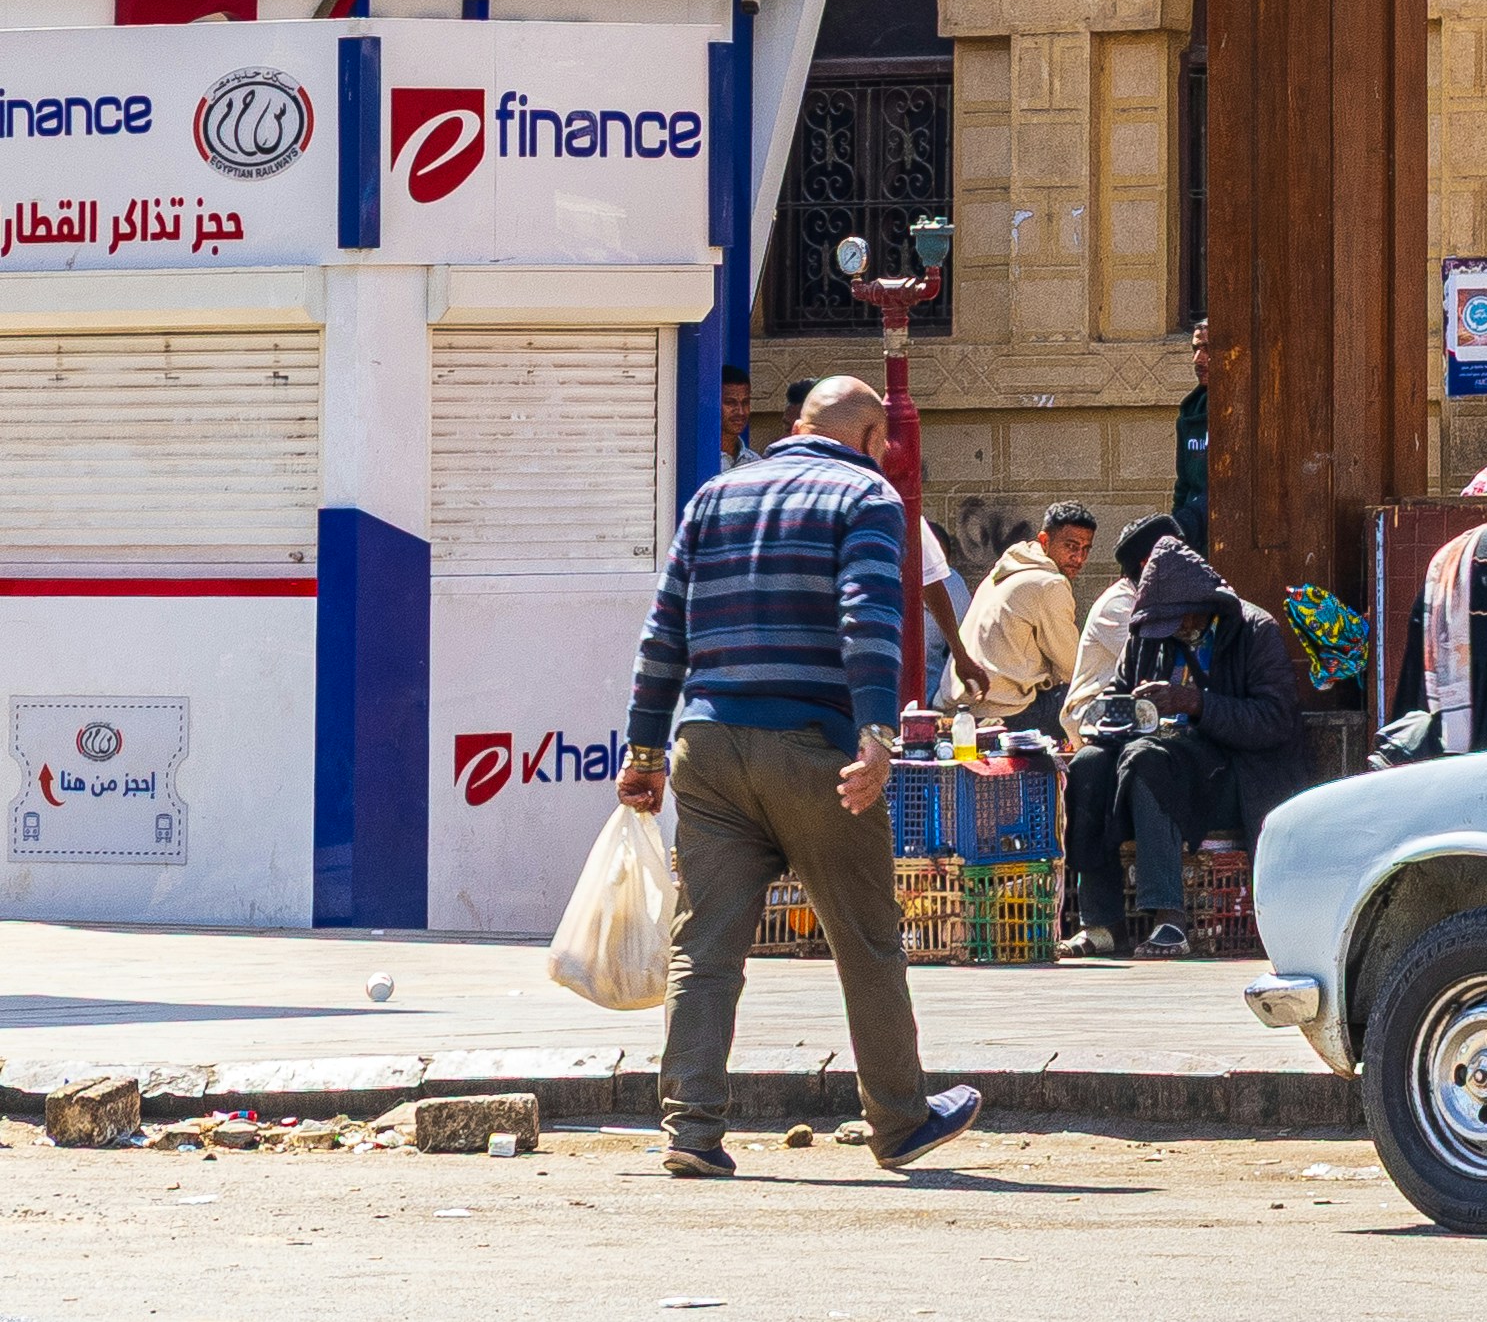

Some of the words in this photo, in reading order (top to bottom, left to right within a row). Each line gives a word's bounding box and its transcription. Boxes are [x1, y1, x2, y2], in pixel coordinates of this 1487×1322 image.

[0, 88, 152, 137] inance
[495, 90, 702, 159] finance
[210, 155, 253, 178] EGYPTIAN
[255, 147, 299, 178] RAILWAYS
[0, 199, 97, 258] القطار
[109, 196, 185, 255] تذاكر
[191, 197, 244, 255] حجز
[60, 770, 86, 792] هنا
[522, 730, 672, 784] Khal
[91, 774, 117, 797] من
[123, 771, 155, 799] إحجز
